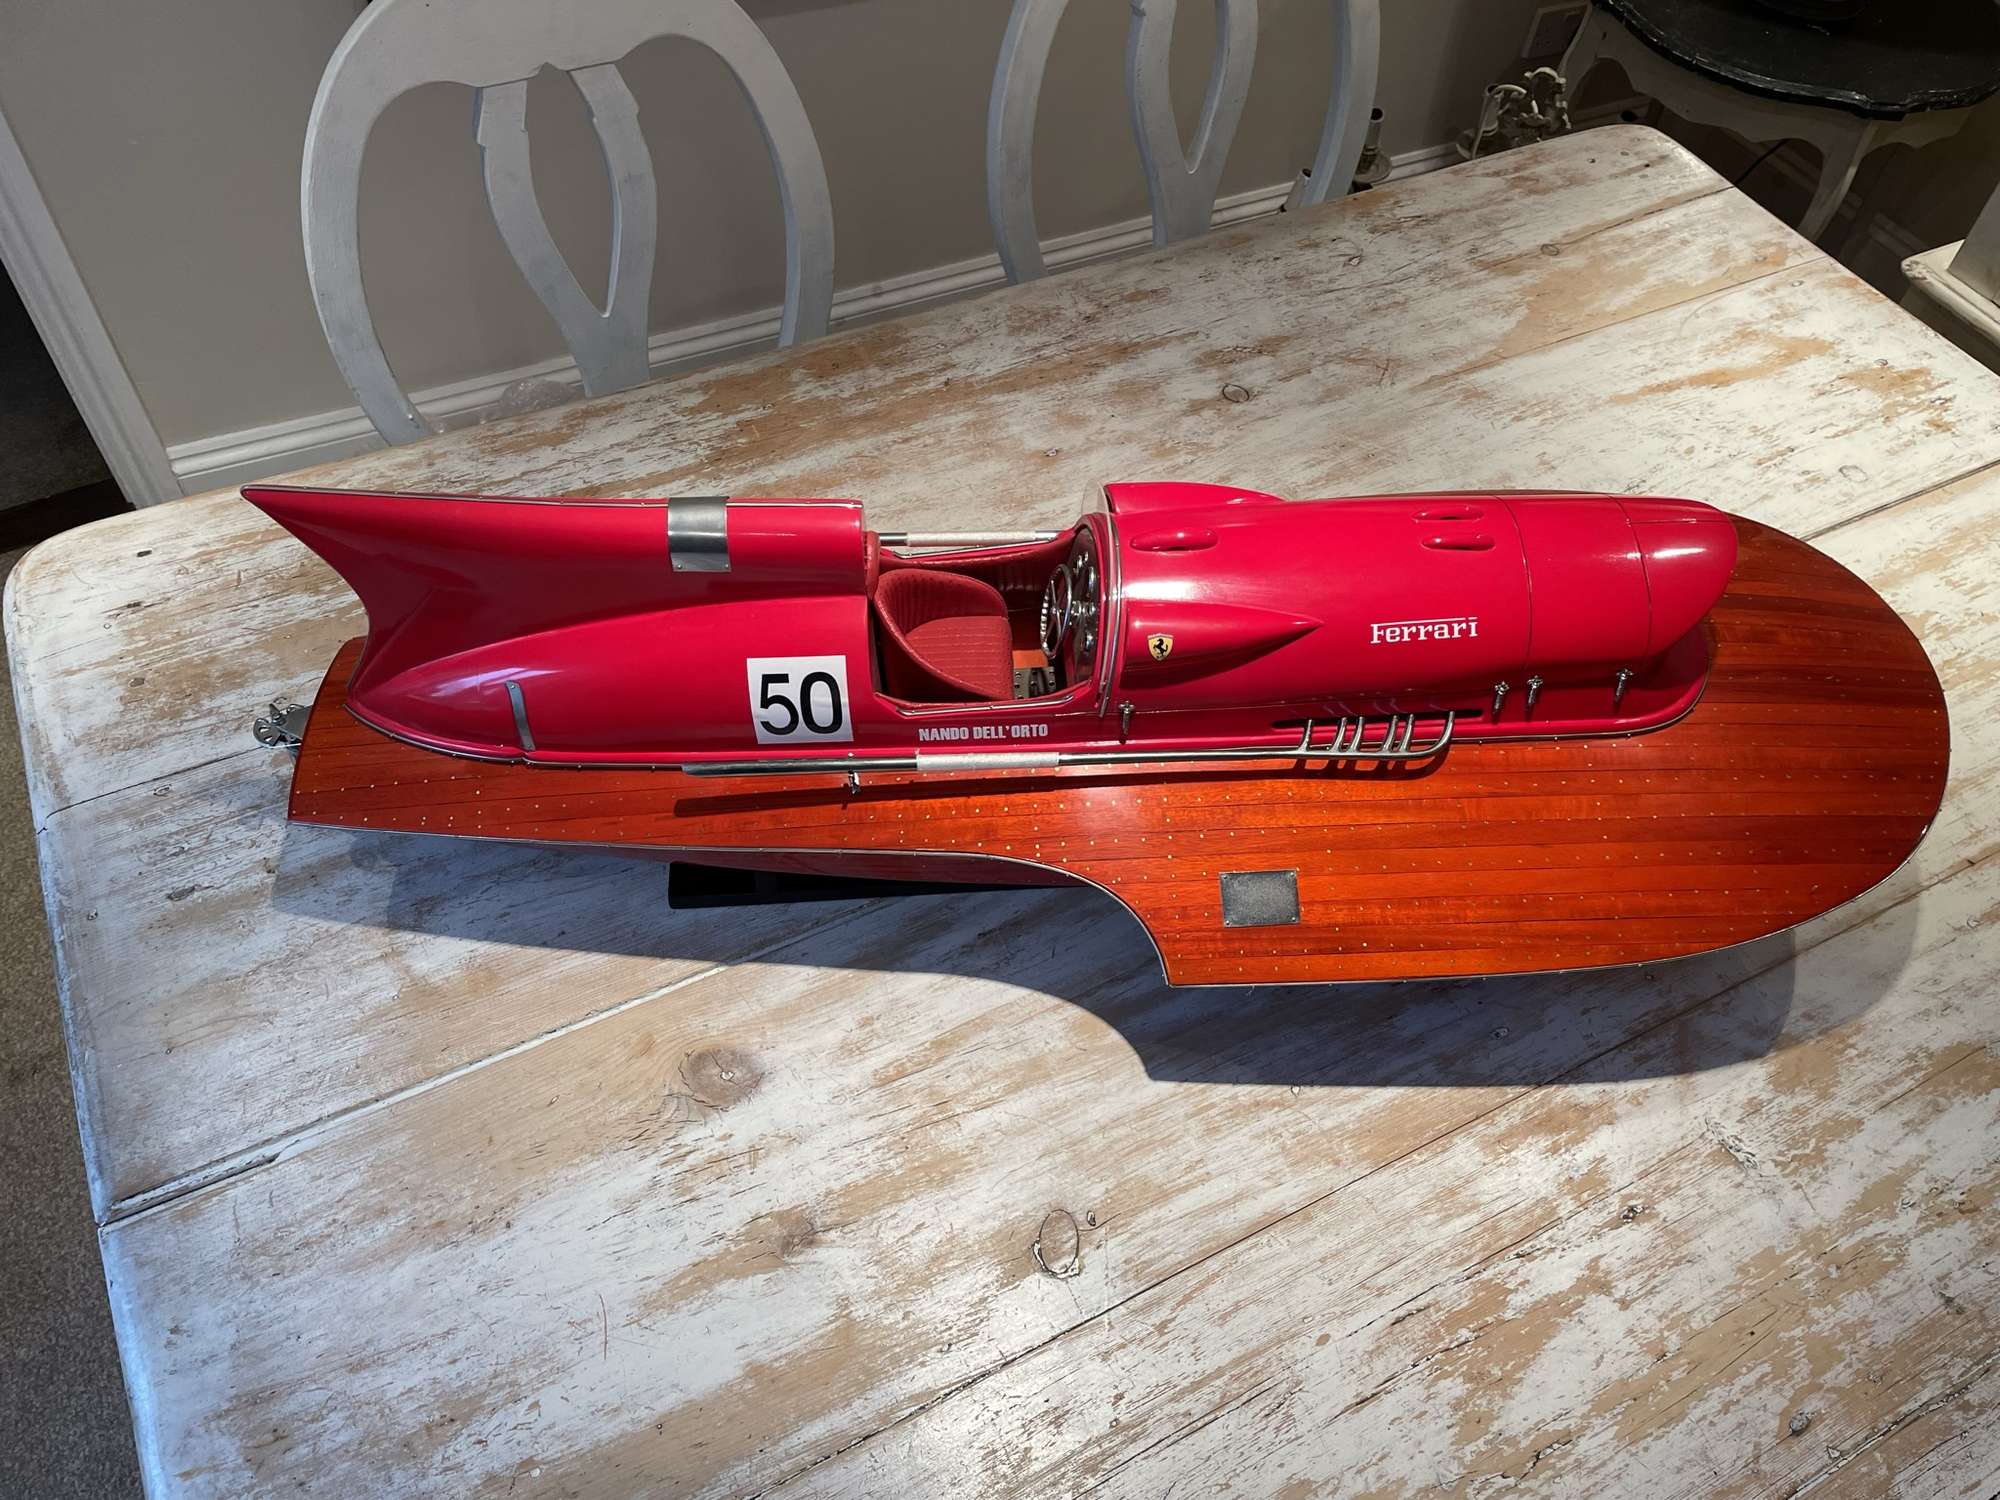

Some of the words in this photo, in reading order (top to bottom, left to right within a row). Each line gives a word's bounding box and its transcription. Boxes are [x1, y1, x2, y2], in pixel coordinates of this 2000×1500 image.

[1370, 616, 1478, 644] Ferrari
[760, 671, 843, 736] 50
[918, 727, 969, 742] NANDO
[973, 723, 1048, 740] DELL'ORTO
